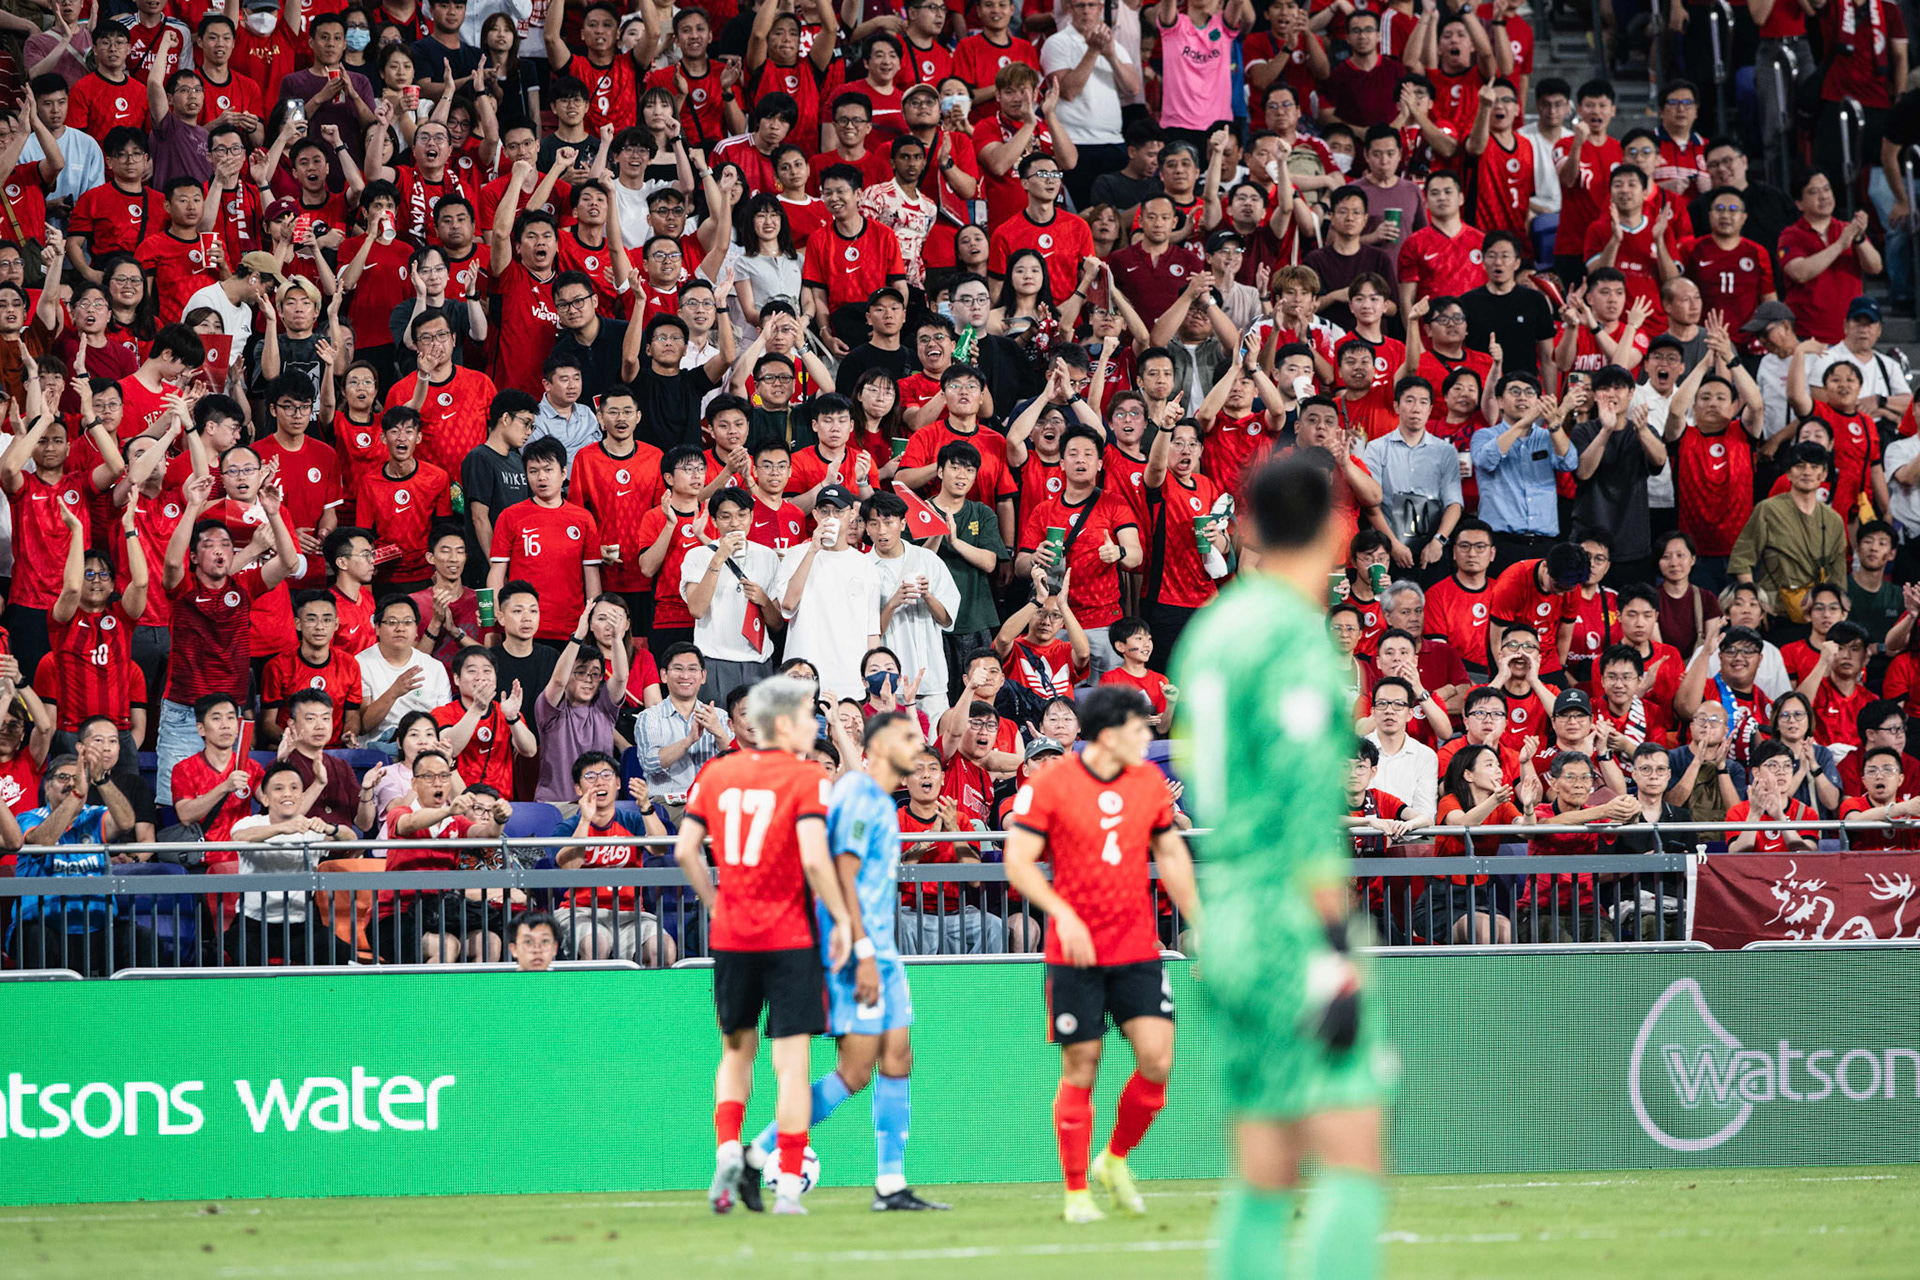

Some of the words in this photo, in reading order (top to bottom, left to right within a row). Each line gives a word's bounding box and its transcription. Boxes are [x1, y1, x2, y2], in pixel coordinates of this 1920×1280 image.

[598, 96, 610, 116] 9
[1719, 272, 1734, 294] 11
[501, 471, 528, 486] NIKE
[522, 534, 541, 557] 16
[773, 536, 790, 549] 17
[90, 643, 109, 666] 10
[718, 787, 777, 867] 17
[0, 1073, 204, 1138] tsons
[234, 1066, 456, 1132] water
